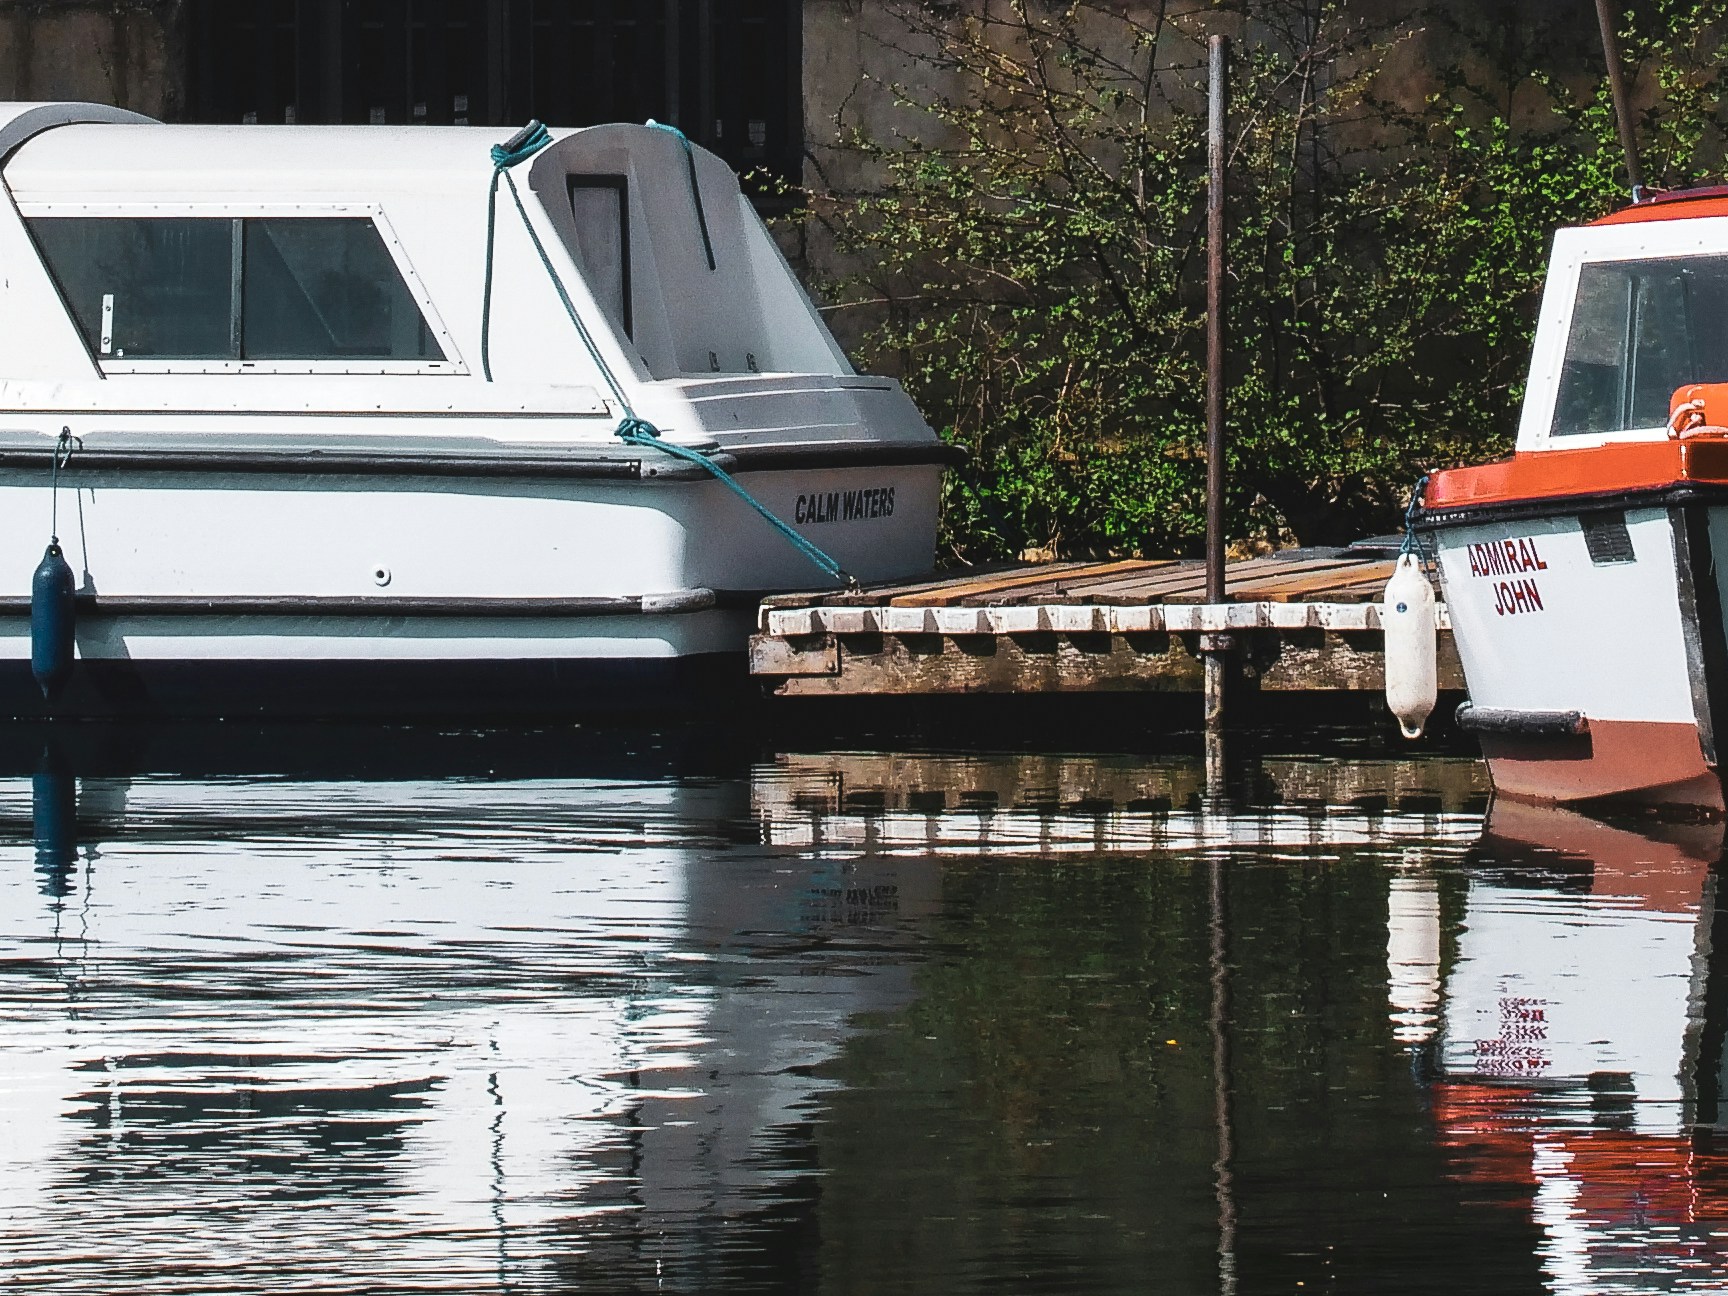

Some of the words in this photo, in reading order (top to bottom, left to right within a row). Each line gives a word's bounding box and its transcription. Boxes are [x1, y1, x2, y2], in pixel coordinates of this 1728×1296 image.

[794, 490, 840, 525] CALM
[842, 486, 896, 522] WATERS
[1465, 536, 1550, 578] ADMIRAL
[1492, 577, 1545, 617] JOHN
